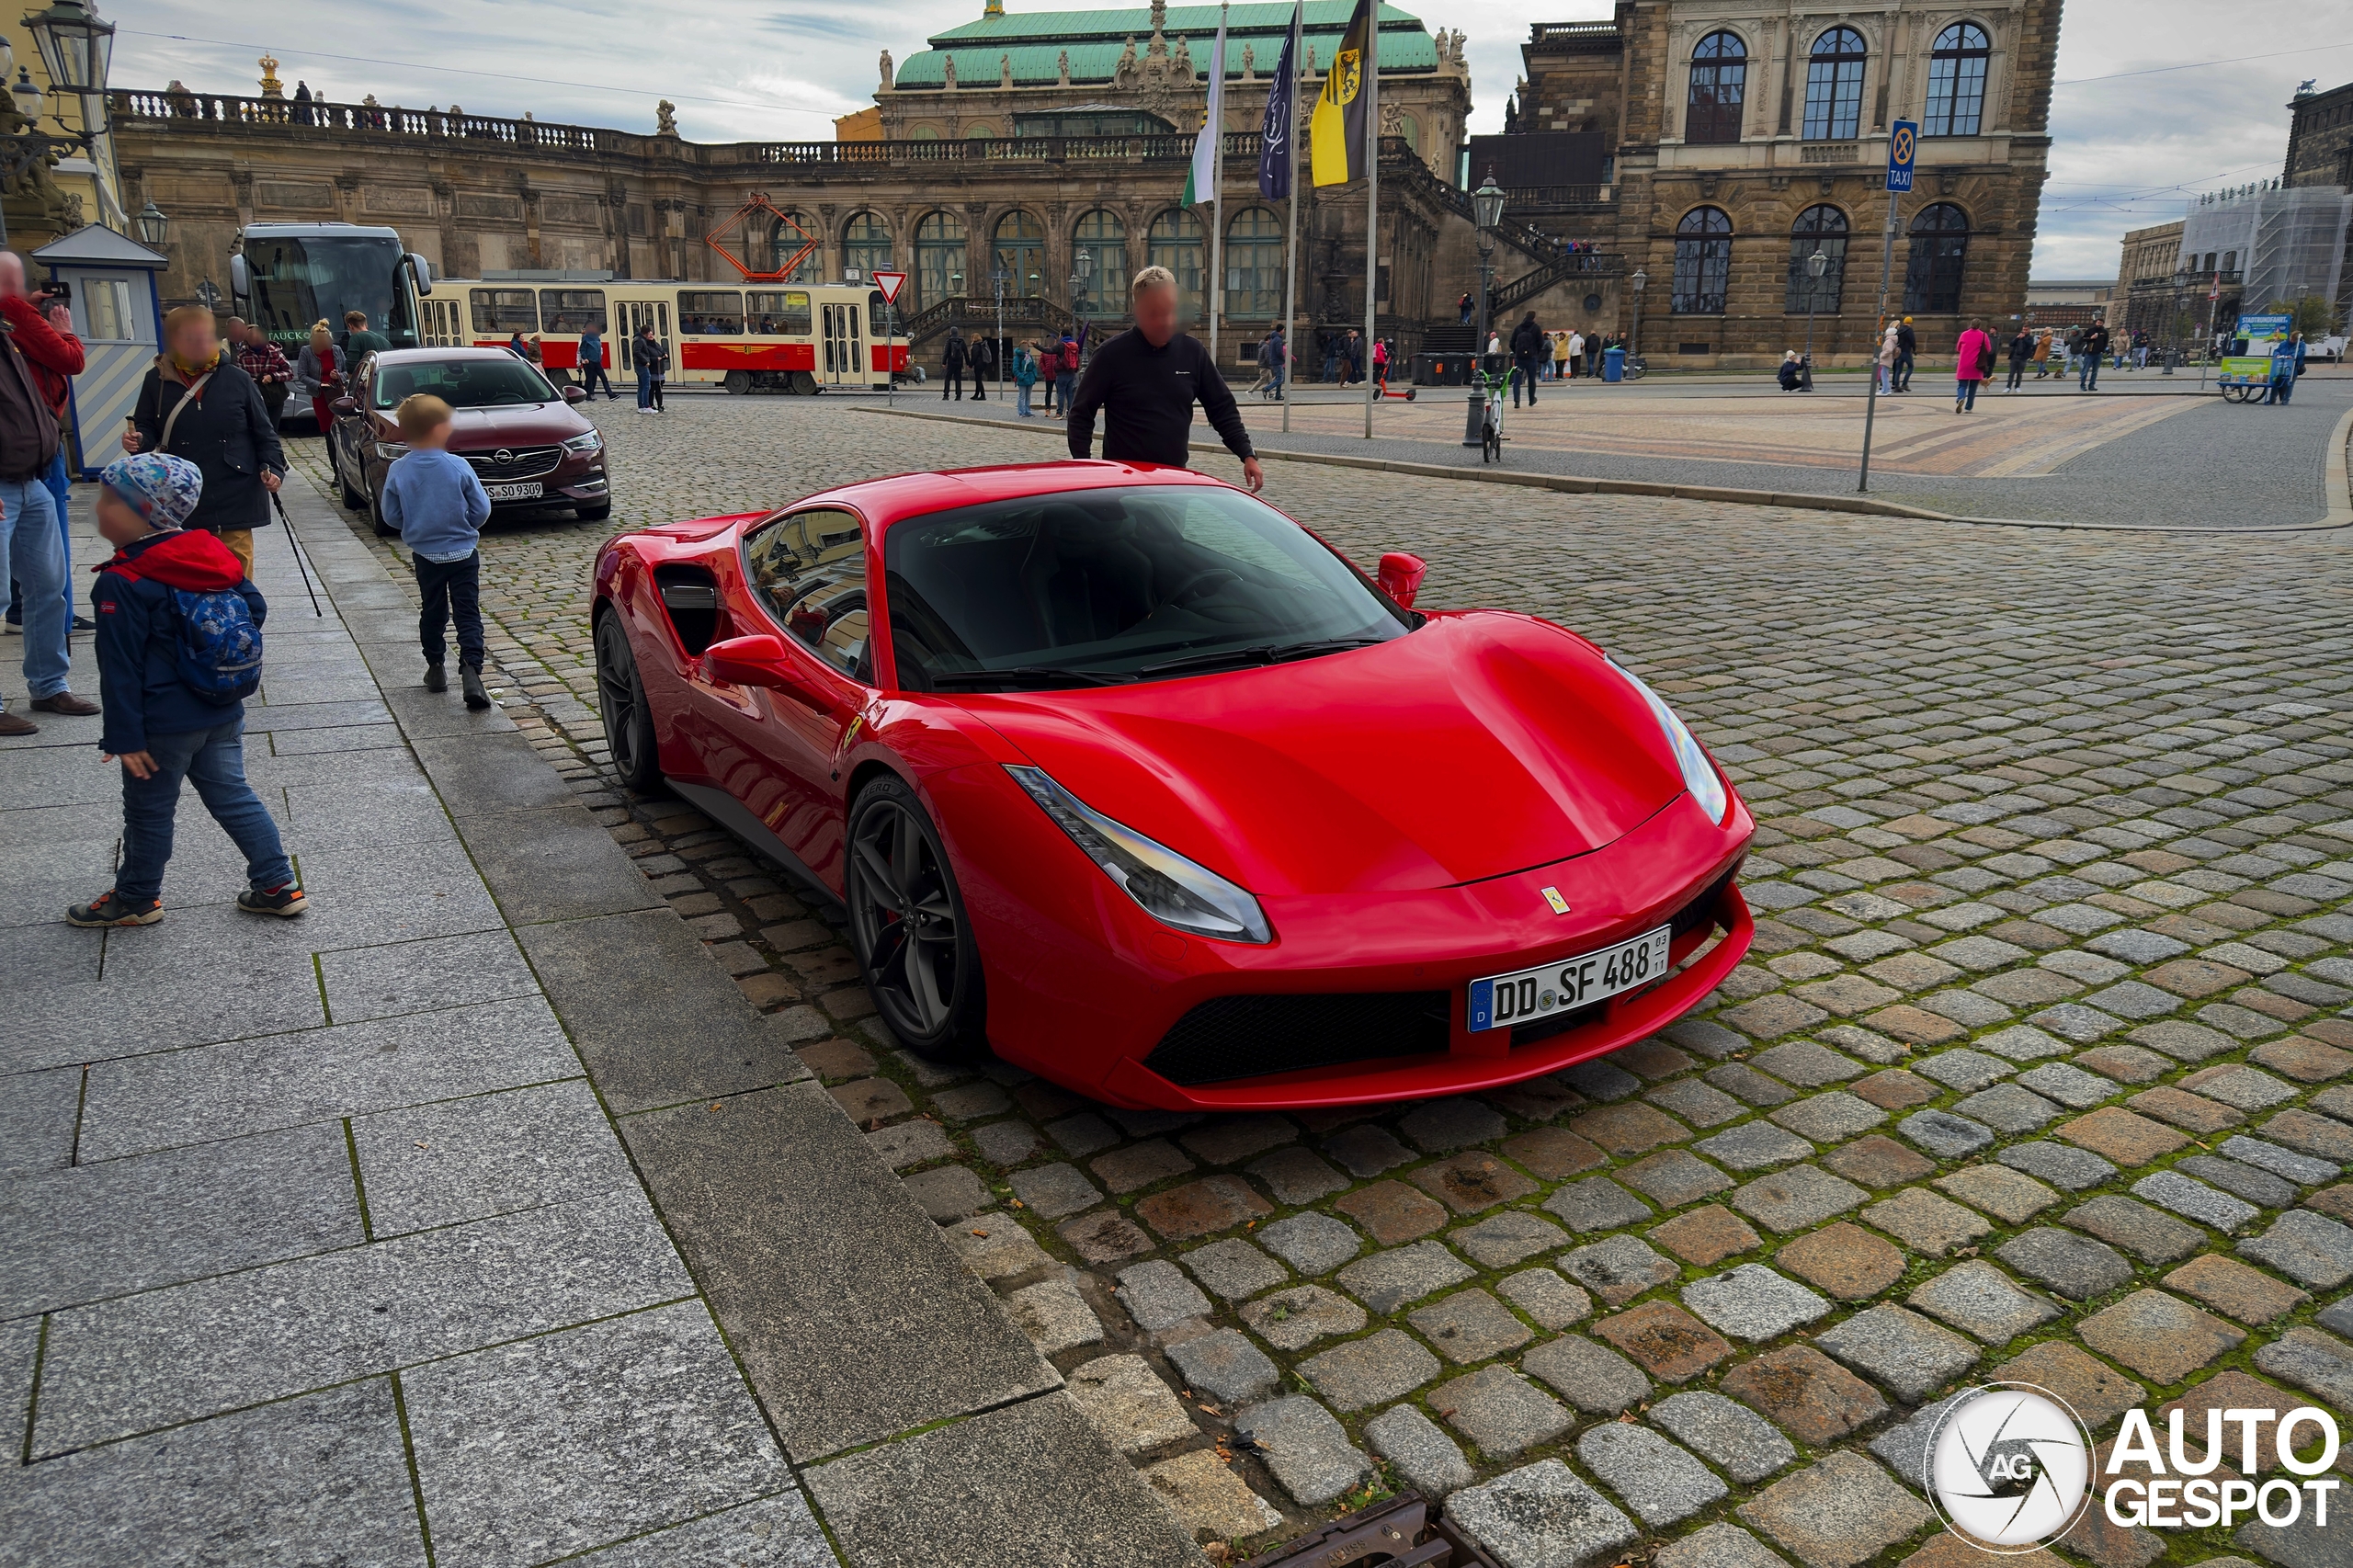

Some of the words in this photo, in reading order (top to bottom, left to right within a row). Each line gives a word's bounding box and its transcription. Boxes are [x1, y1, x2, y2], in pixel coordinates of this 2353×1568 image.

[1890, 170, 1911, 186] TAXI
[268, 332, 303, 340] TAUCK
[517, 483, 540, 496] 9309
[864, 783, 892, 798] ZERO
[1655, 934, 1666, 947] 03
[1654, 959, 1665, 972] 11
[1477, 1011, 1485, 1023] D
[1495, 977, 1537, 1021] DD
[1558, 960, 1597, 1006] SF
[1603, 942, 1649, 990] 488
